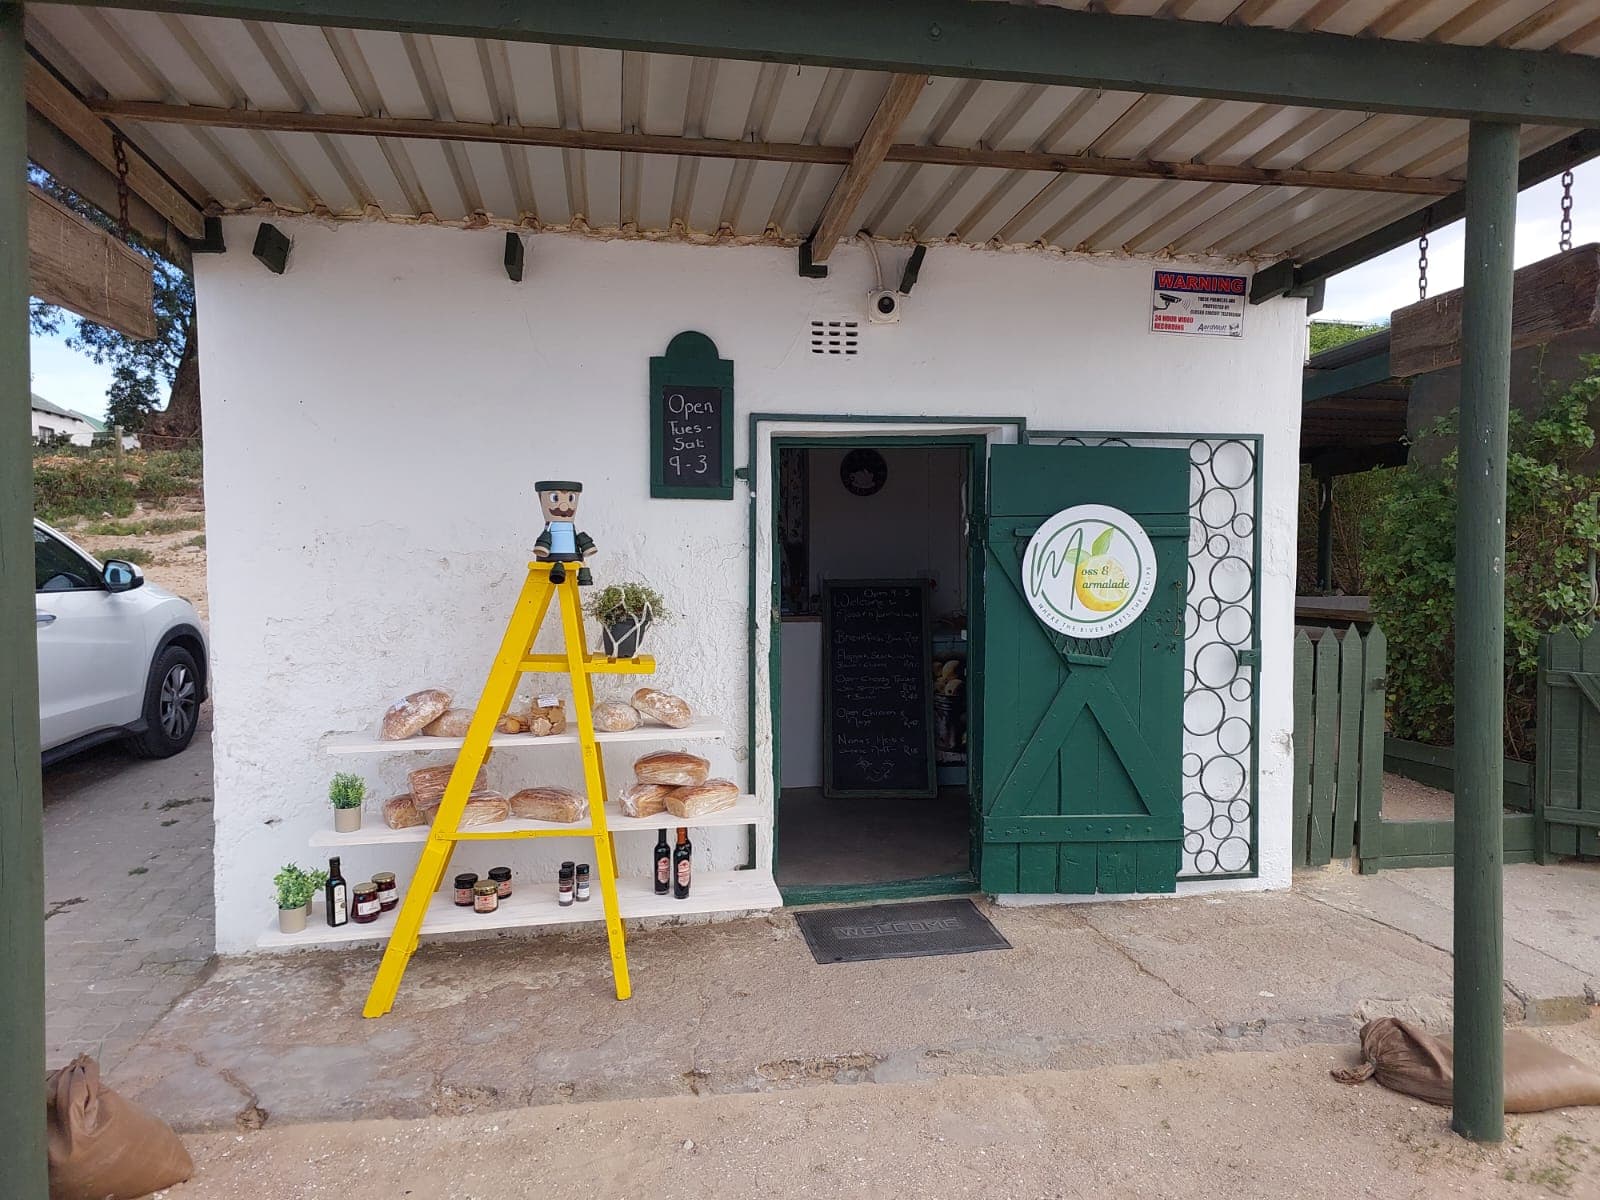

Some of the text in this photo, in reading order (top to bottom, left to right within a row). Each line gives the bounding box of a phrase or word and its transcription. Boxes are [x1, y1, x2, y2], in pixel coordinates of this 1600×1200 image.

[1158, 273, 1244, 293] WARNING
[1154, 322, 1185, 331] RECORDING
[669, 394, 714, 420] Open
[668, 421, 702, 435] Tues
[673, 437, 705, 451] Sat
[669, 455, 681, 476] 9
[695, 454, 708, 474] 3
[1038, 603, 1060, 625] WHERE
[1062, 622, 1077, 632] THE
[1107, 612, 1132, 630] MEETS
[1132, 598, 1144, 612] THE
[1141, 566, 1153, 596] RECIPE
[839, 917, 961, 937] WELCOME
